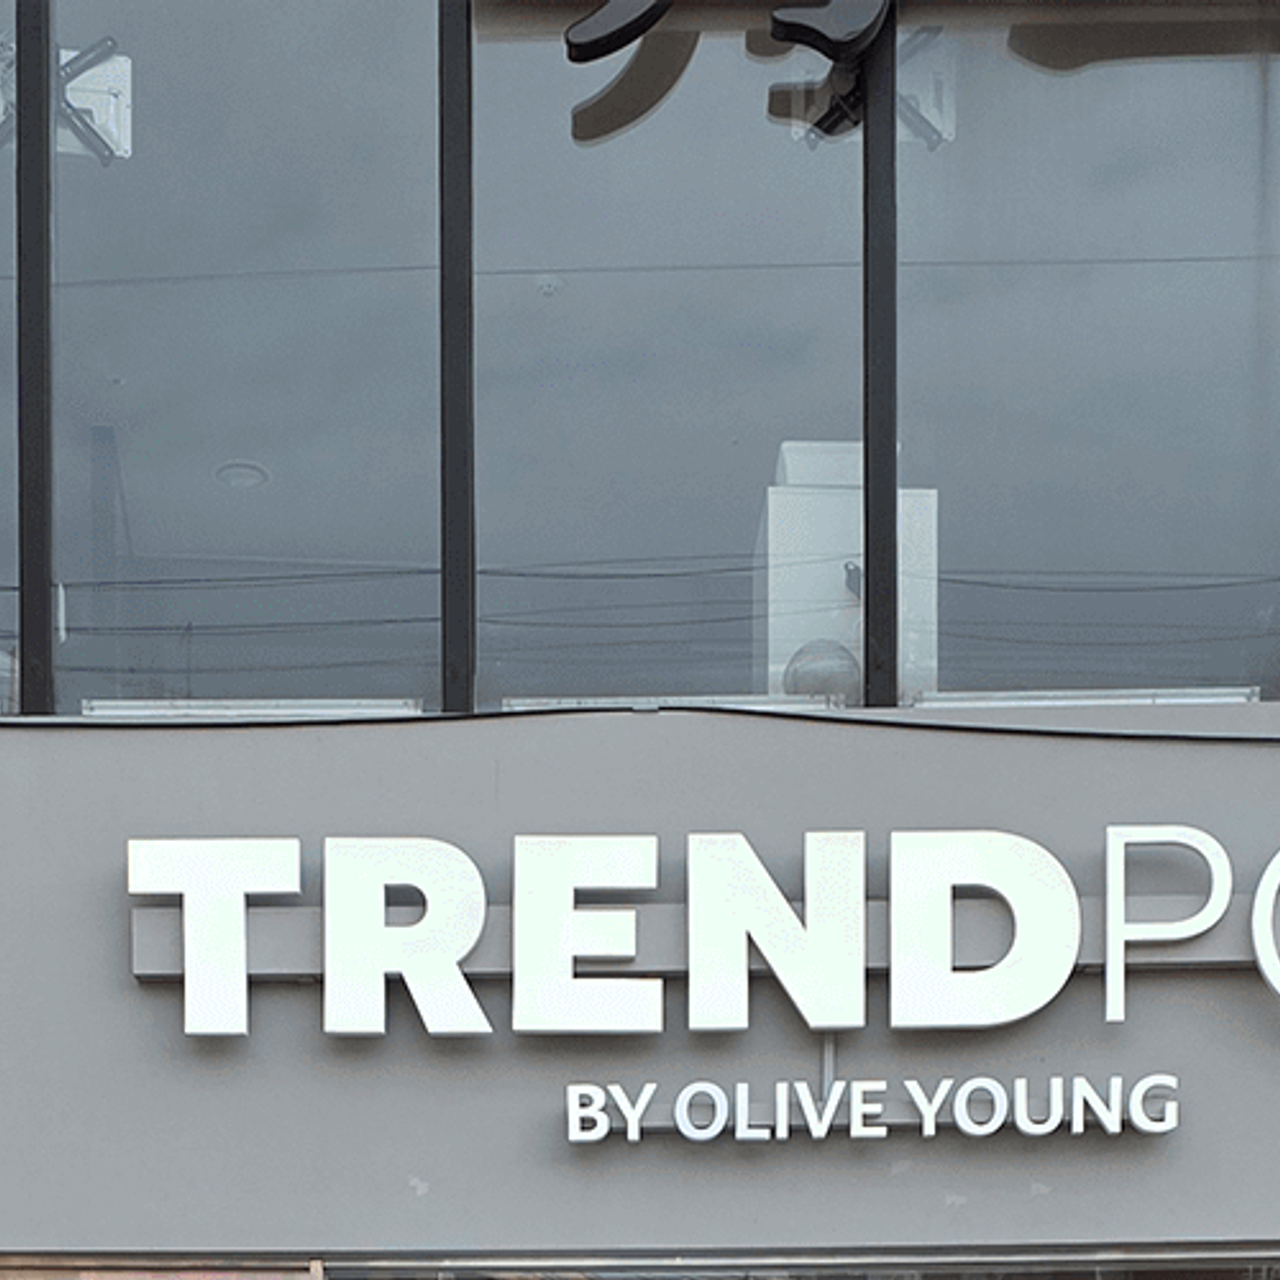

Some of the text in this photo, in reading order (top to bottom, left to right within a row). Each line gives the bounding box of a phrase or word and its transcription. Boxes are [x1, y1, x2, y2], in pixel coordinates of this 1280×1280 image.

[567, 1074, 1180, 1142] BY OLIVE YOUNG
